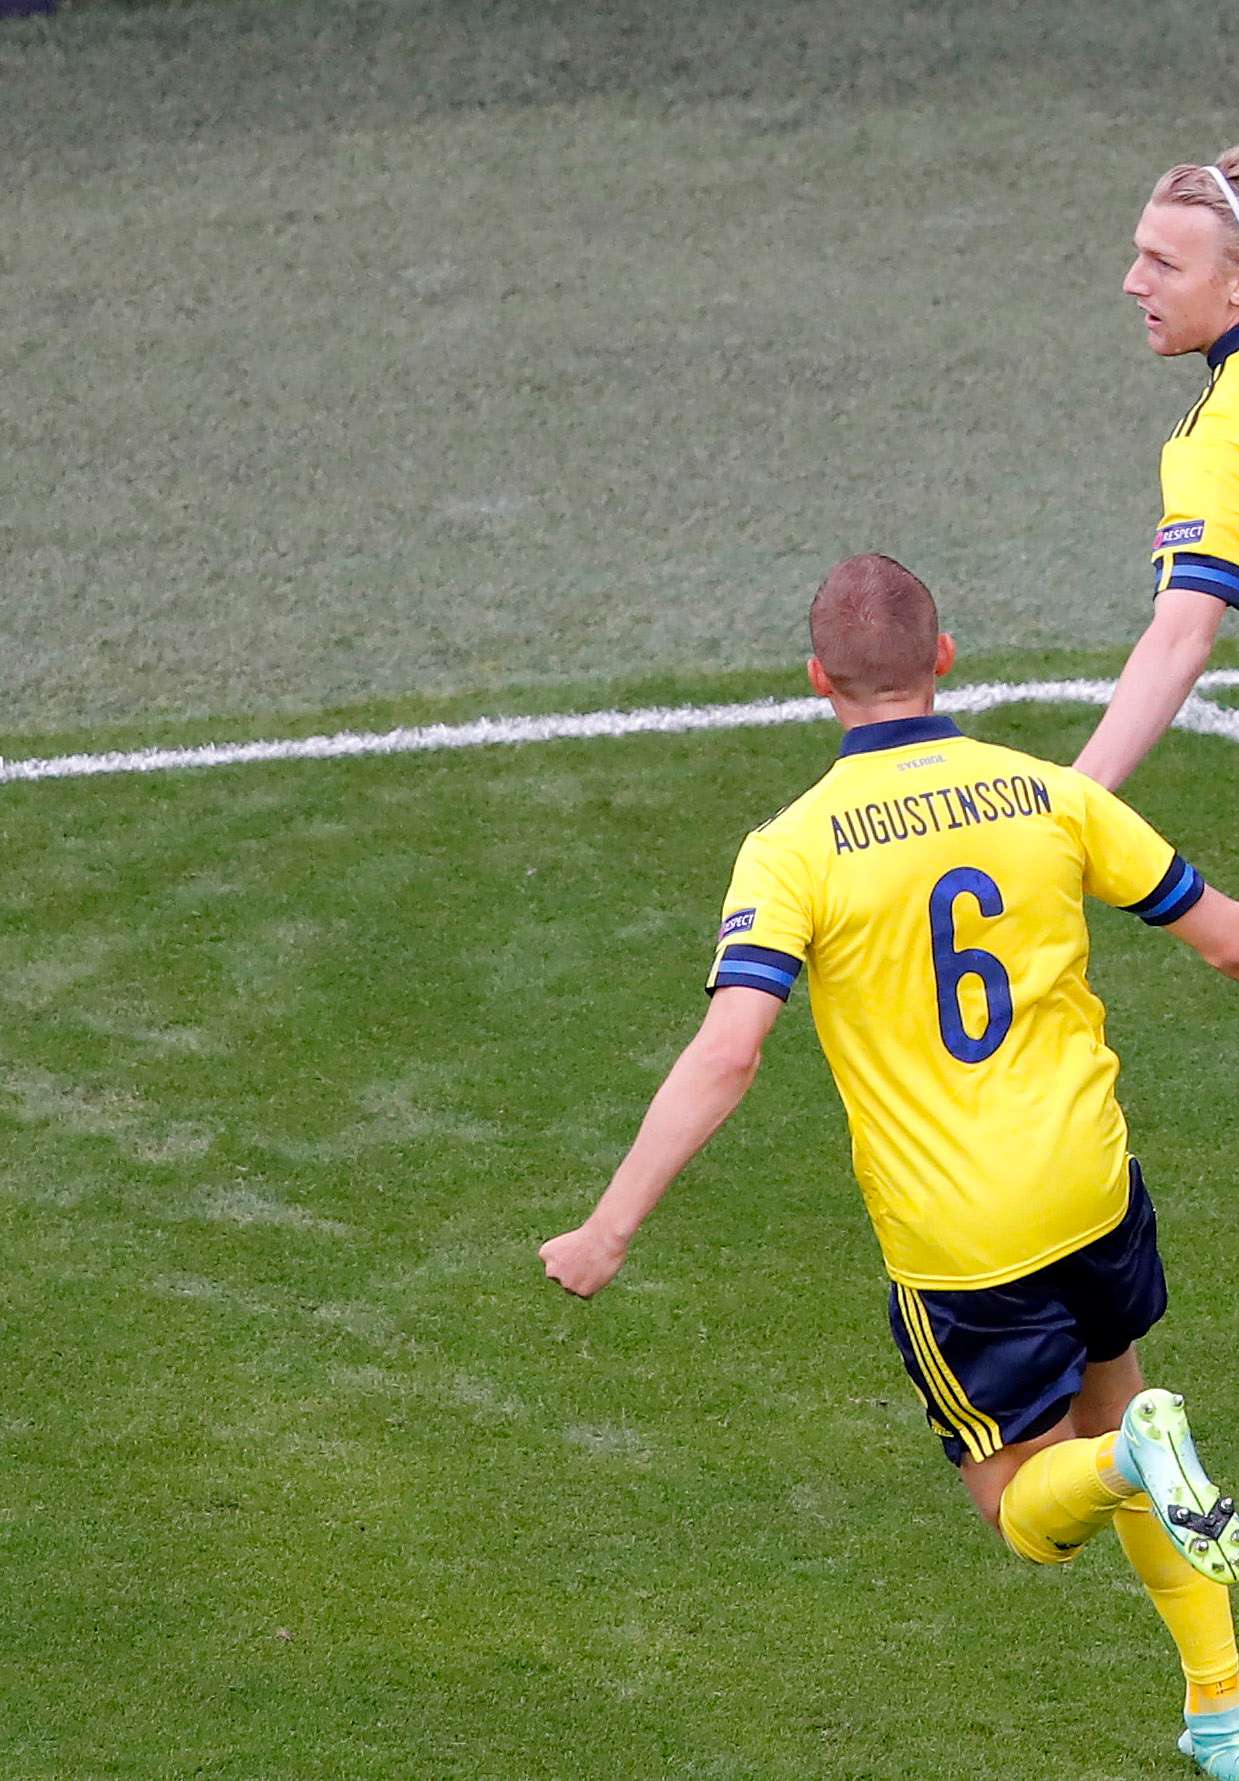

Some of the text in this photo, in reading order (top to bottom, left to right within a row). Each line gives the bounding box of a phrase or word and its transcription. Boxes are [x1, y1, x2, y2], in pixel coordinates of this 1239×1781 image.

[1163, 526, 1203, 541] RESPECT
[830, 775, 1051, 856] AUGUSTINSSON
[929, 866, 1014, 1064] 6
